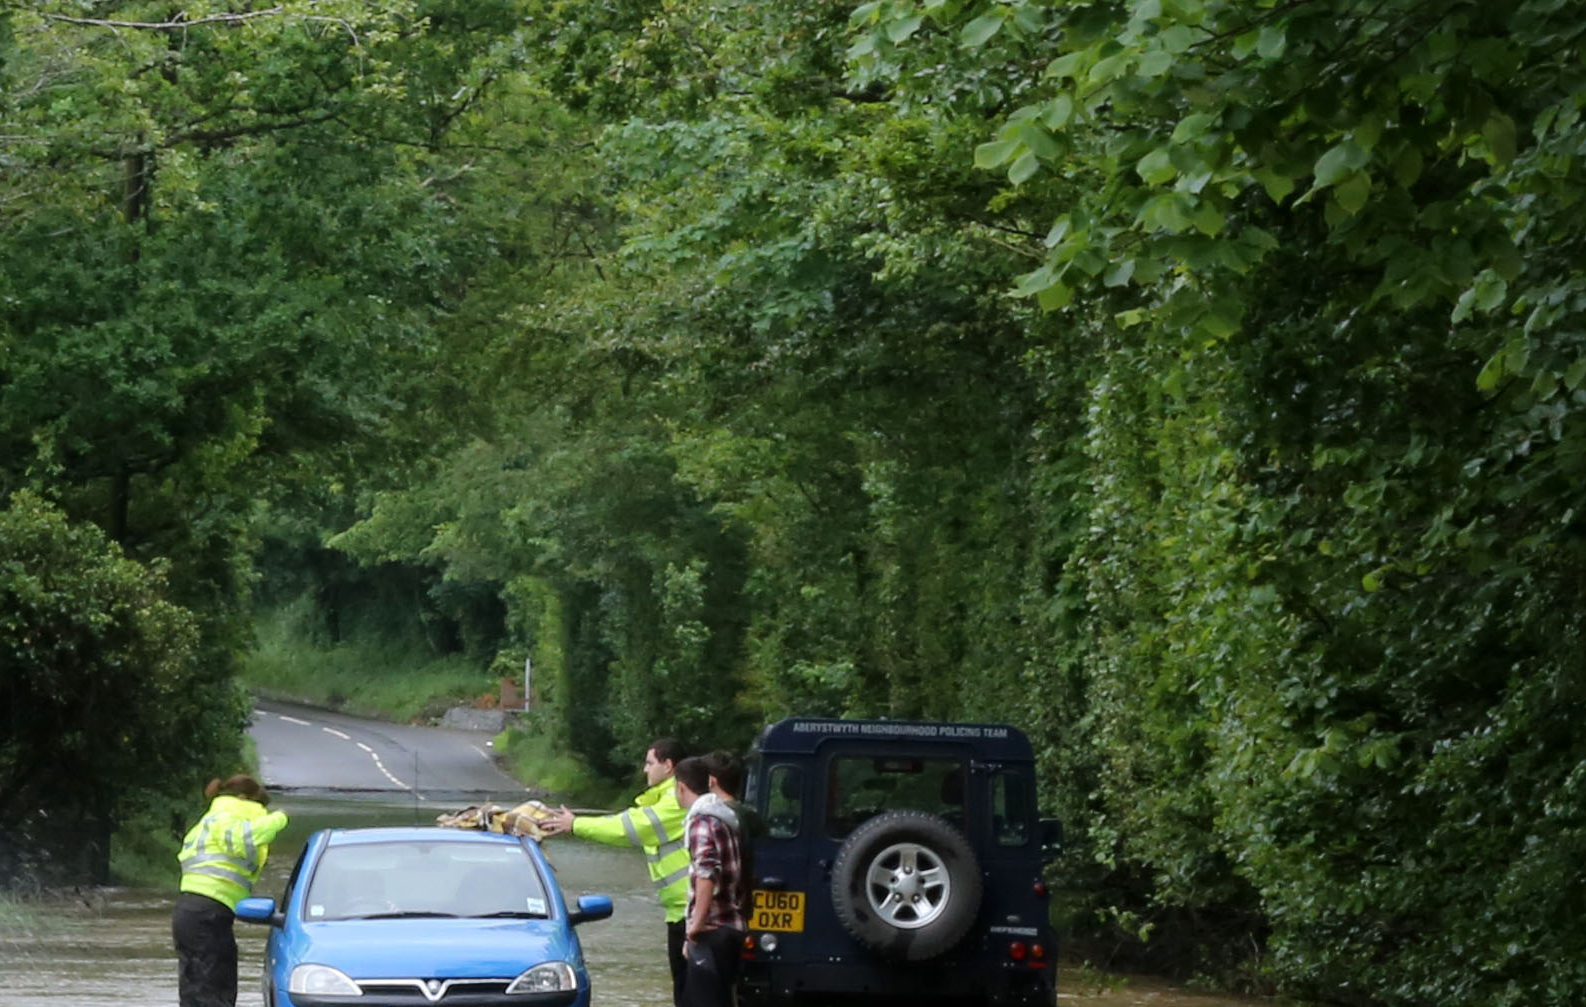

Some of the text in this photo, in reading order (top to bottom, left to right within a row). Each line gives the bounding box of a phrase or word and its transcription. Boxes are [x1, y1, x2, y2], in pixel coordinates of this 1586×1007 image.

[793, 722, 1008, 738] ABERYSTWYTH NEIGHBOURHOOD POLICING TEAM
[754, 892, 799, 910] CU60
[759, 912, 793, 928] OXR
